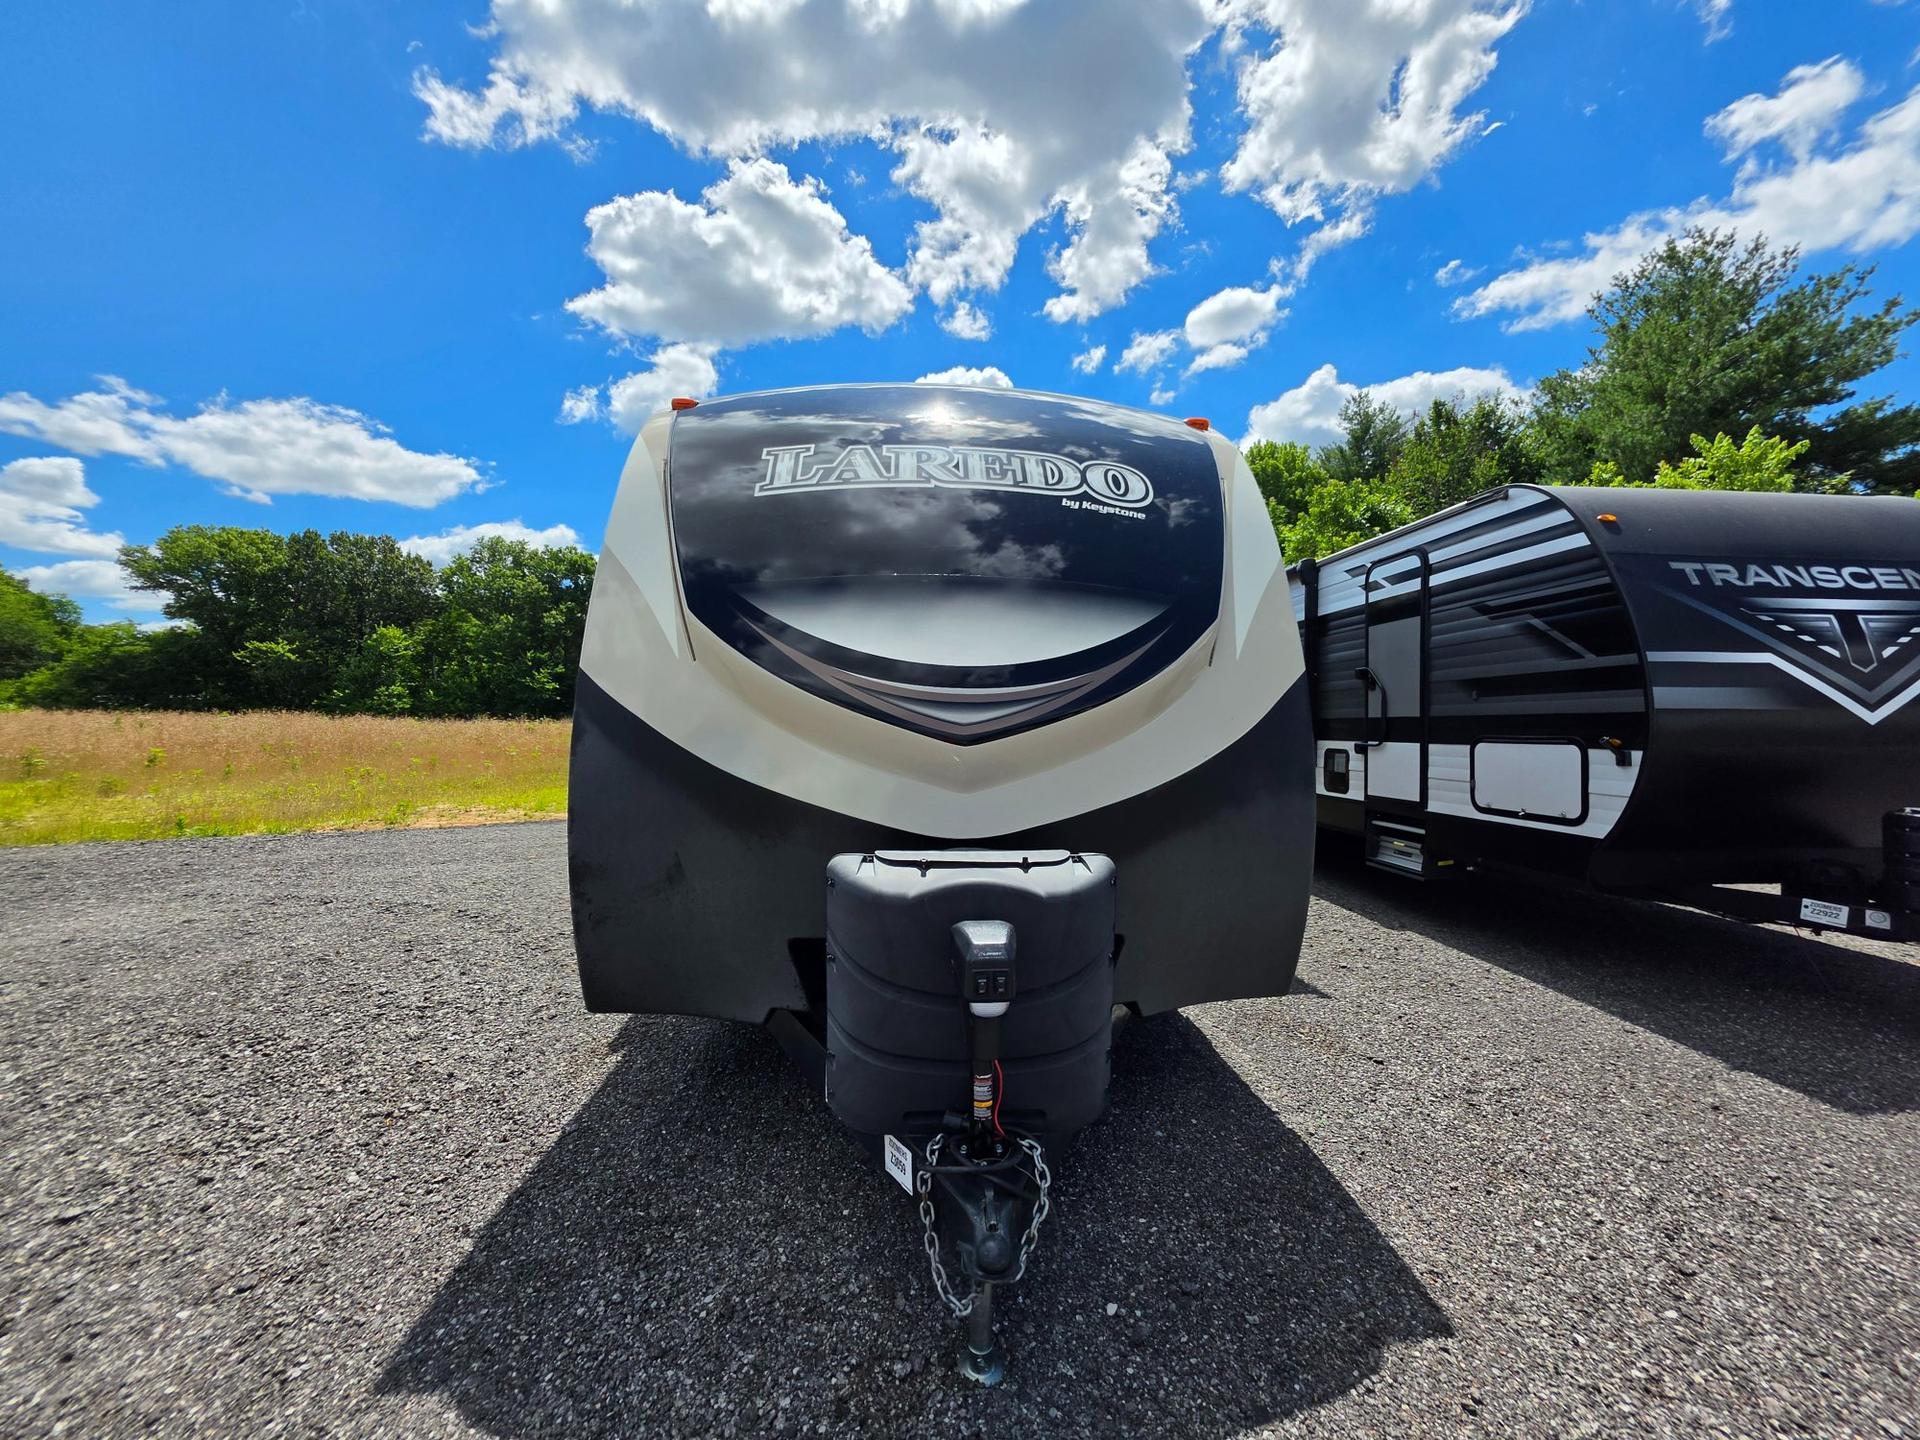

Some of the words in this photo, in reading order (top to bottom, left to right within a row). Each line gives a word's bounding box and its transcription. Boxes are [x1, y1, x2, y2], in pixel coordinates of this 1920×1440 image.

[754, 444, 1154, 507] LAREDO
[1061, 498, 1080, 510] by
[1082, 501, 1146, 520] Keystone
[1810, 908, 1841, 920] Z2922
